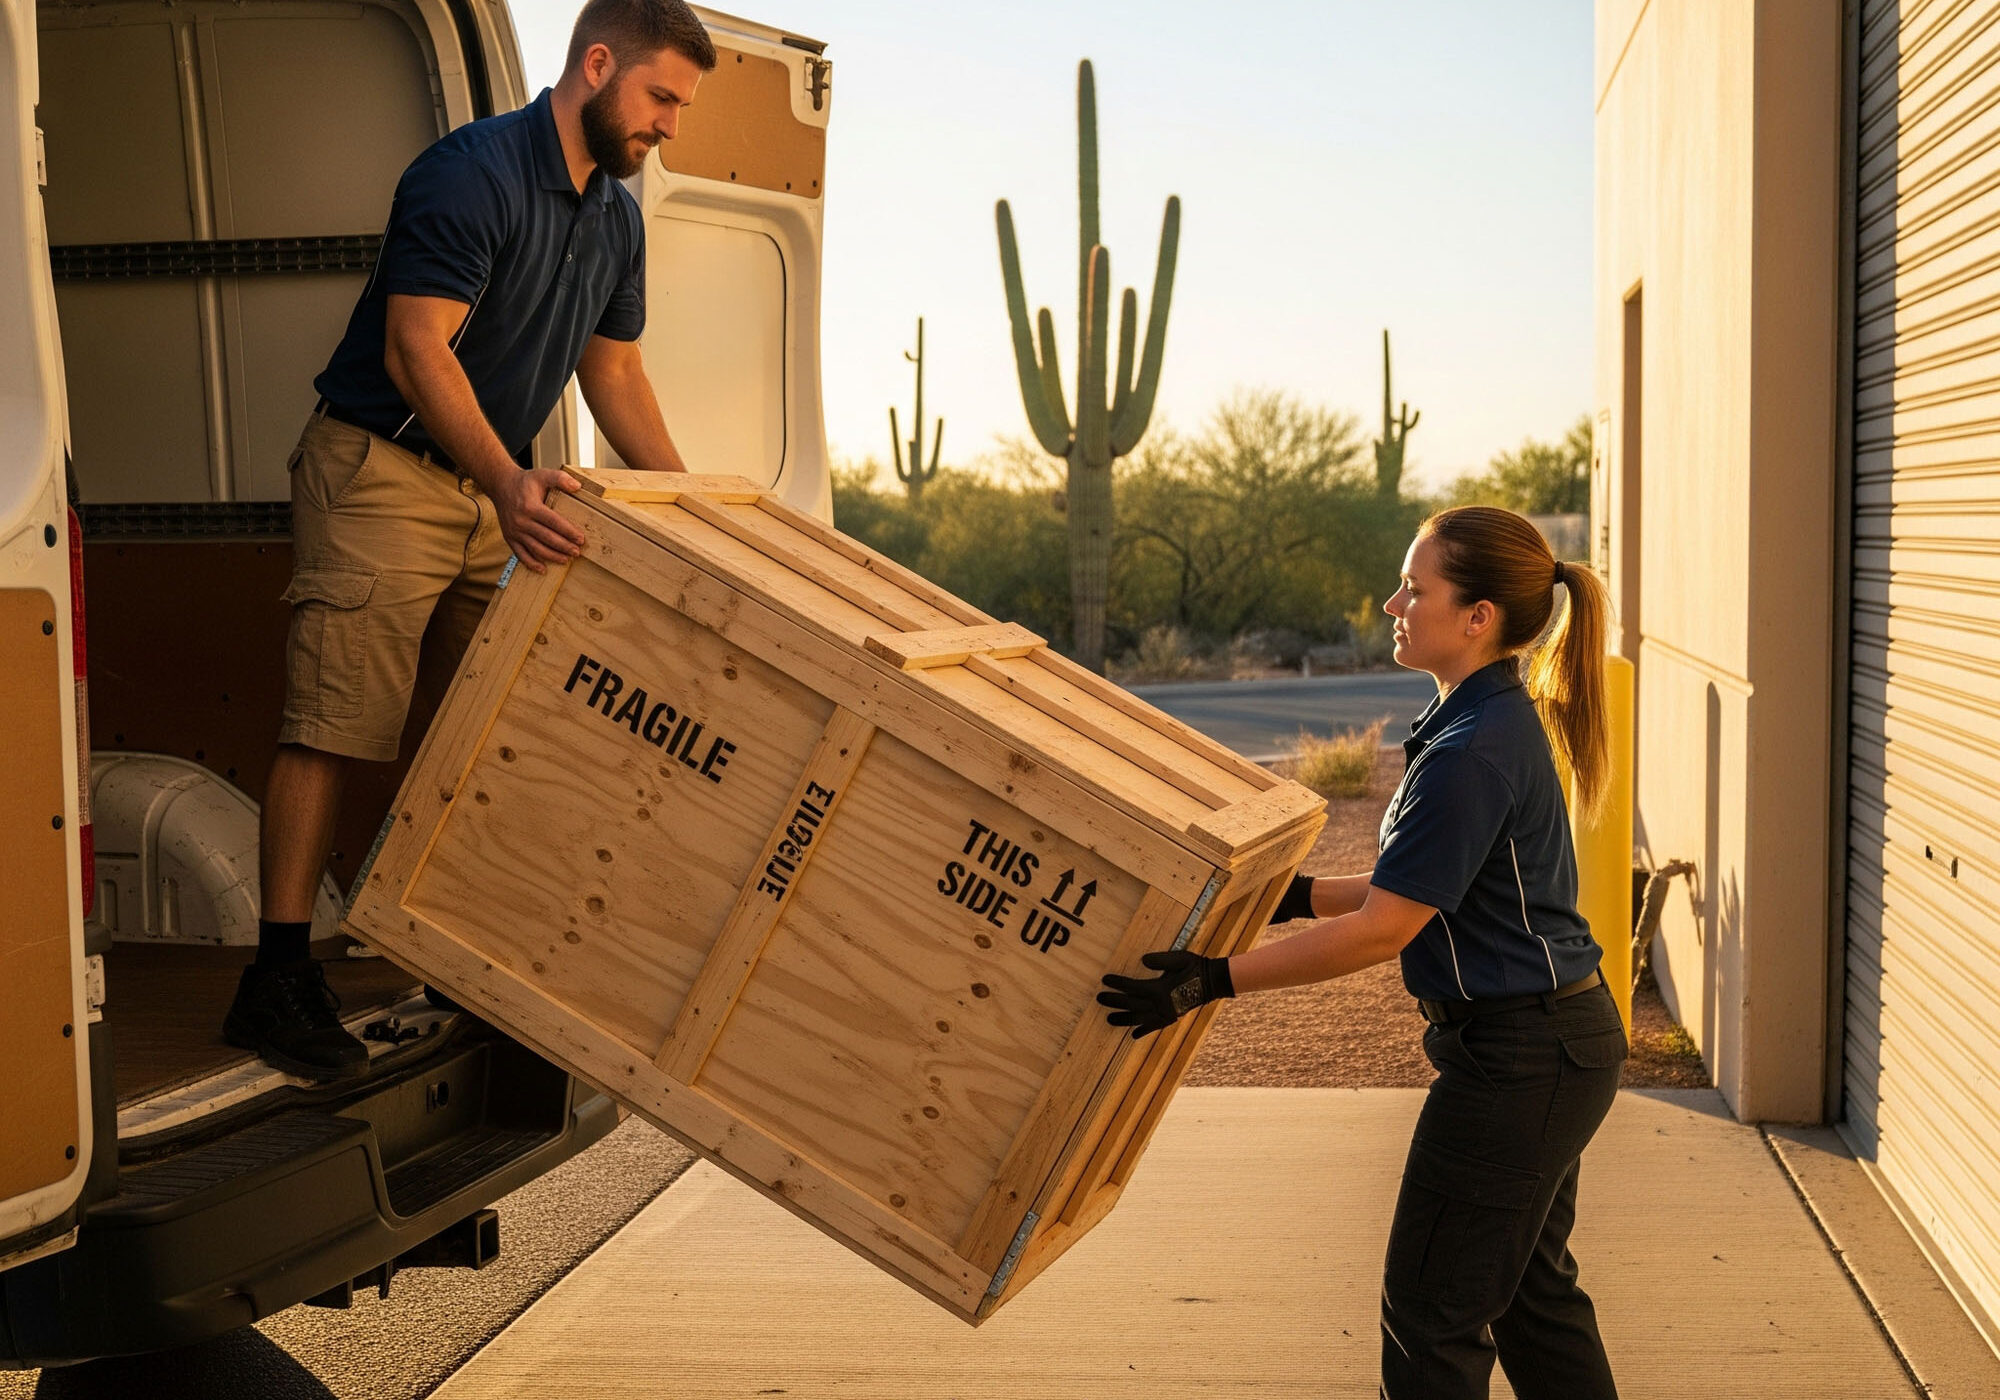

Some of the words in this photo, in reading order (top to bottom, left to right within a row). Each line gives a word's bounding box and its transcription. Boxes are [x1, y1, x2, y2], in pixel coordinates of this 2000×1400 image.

[563, 653, 737, 784] FRAGILE
[961, 818, 1040, 888] THIS
[937, 861, 1018, 929] SIDE
[1020, 908, 1071, 954] UP
